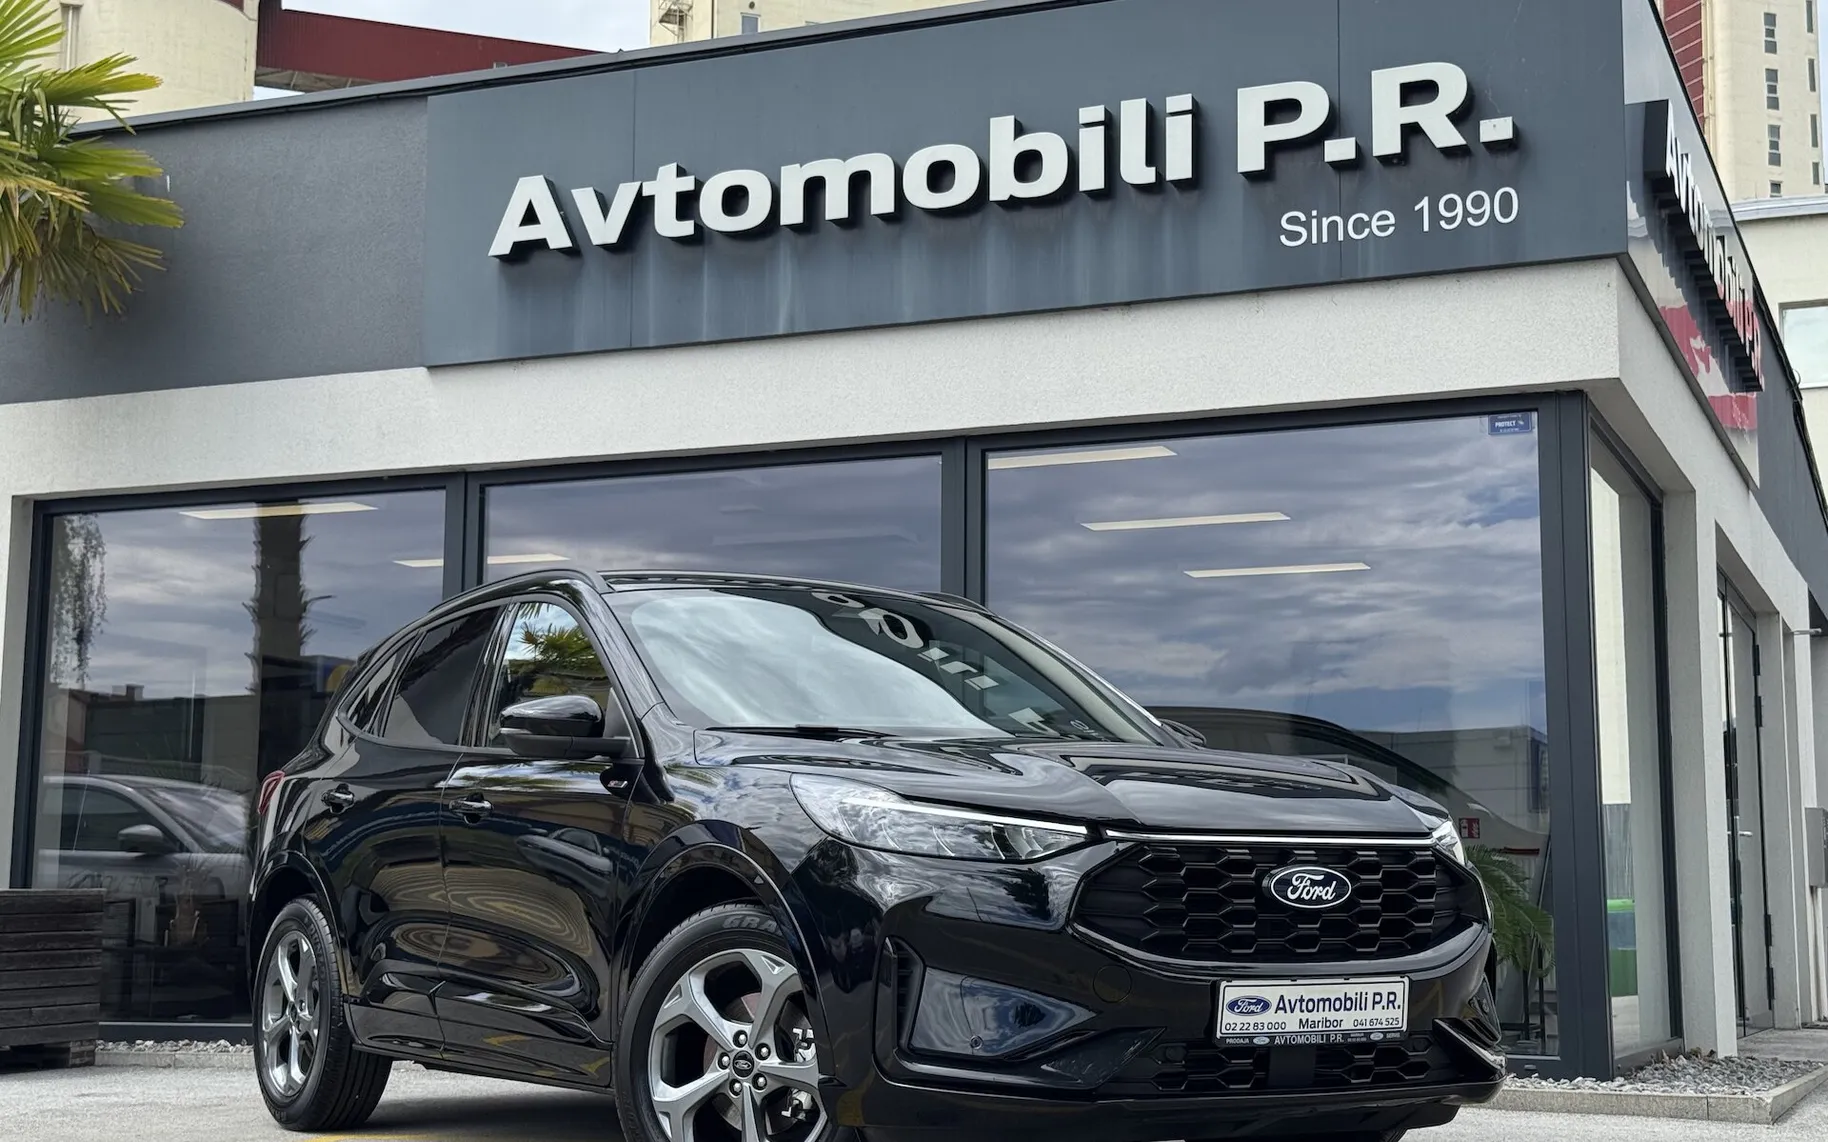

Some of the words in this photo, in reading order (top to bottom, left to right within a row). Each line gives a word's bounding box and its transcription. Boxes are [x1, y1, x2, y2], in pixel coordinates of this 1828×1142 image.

[488, 93, 1194, 257] Avtomobili
[1237, 61, 1514, 174] P.R.
[1279, 208, 1397, 248] Since
[1413, 186, 1520, 234] 1990
[1287, 873, 1337, 900] Ford
[1234, 998, 1264, 1013] Ford
[1274, 991, 1368, 1014] Avtomobili
[1371, 991, 1401, 1011] P.R.
[1224, 1022, 1238, 1031] 02
[1239, 1022, 1251, 1031] 22
[1252, 1021, 1265, 1031] 83
[1266, 1021, 1287, 1031] 000
[1298, 1017, 1344, 1030] Maribor
[1353, 1018, 1367, 1027] 041
[1368, 1018, 1384, 1027] 674
[1384, 1017, 1400, 1026] 525
[1274, 1035, 1326, 1045] AVTOMOBILI
